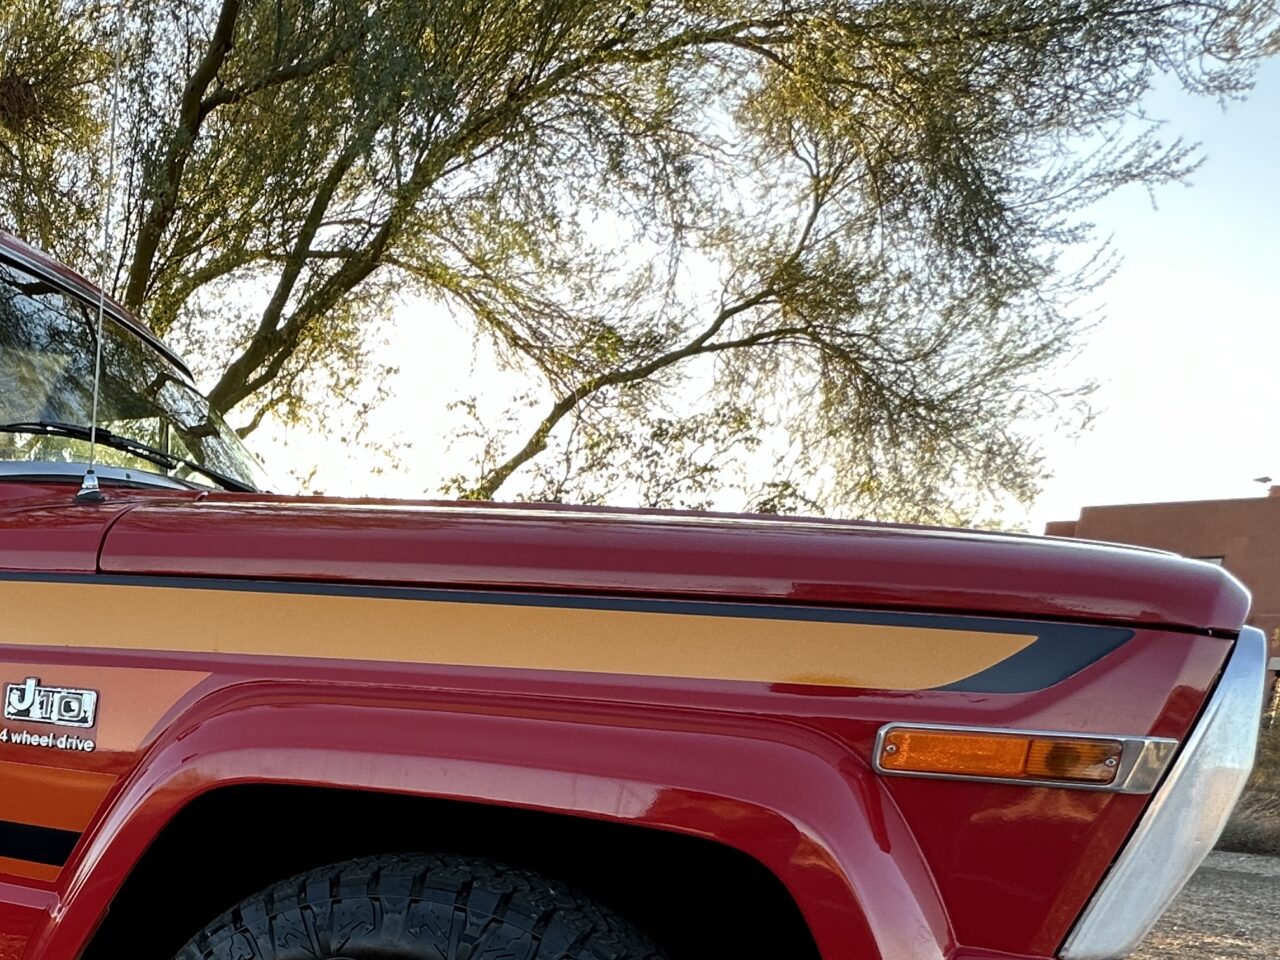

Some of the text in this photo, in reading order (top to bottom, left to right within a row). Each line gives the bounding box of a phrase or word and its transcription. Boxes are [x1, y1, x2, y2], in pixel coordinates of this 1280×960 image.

[9, 677, 84, 720] J10
[11, 730, 53, 747] wheel
[56, 735, 95, 751] drive
